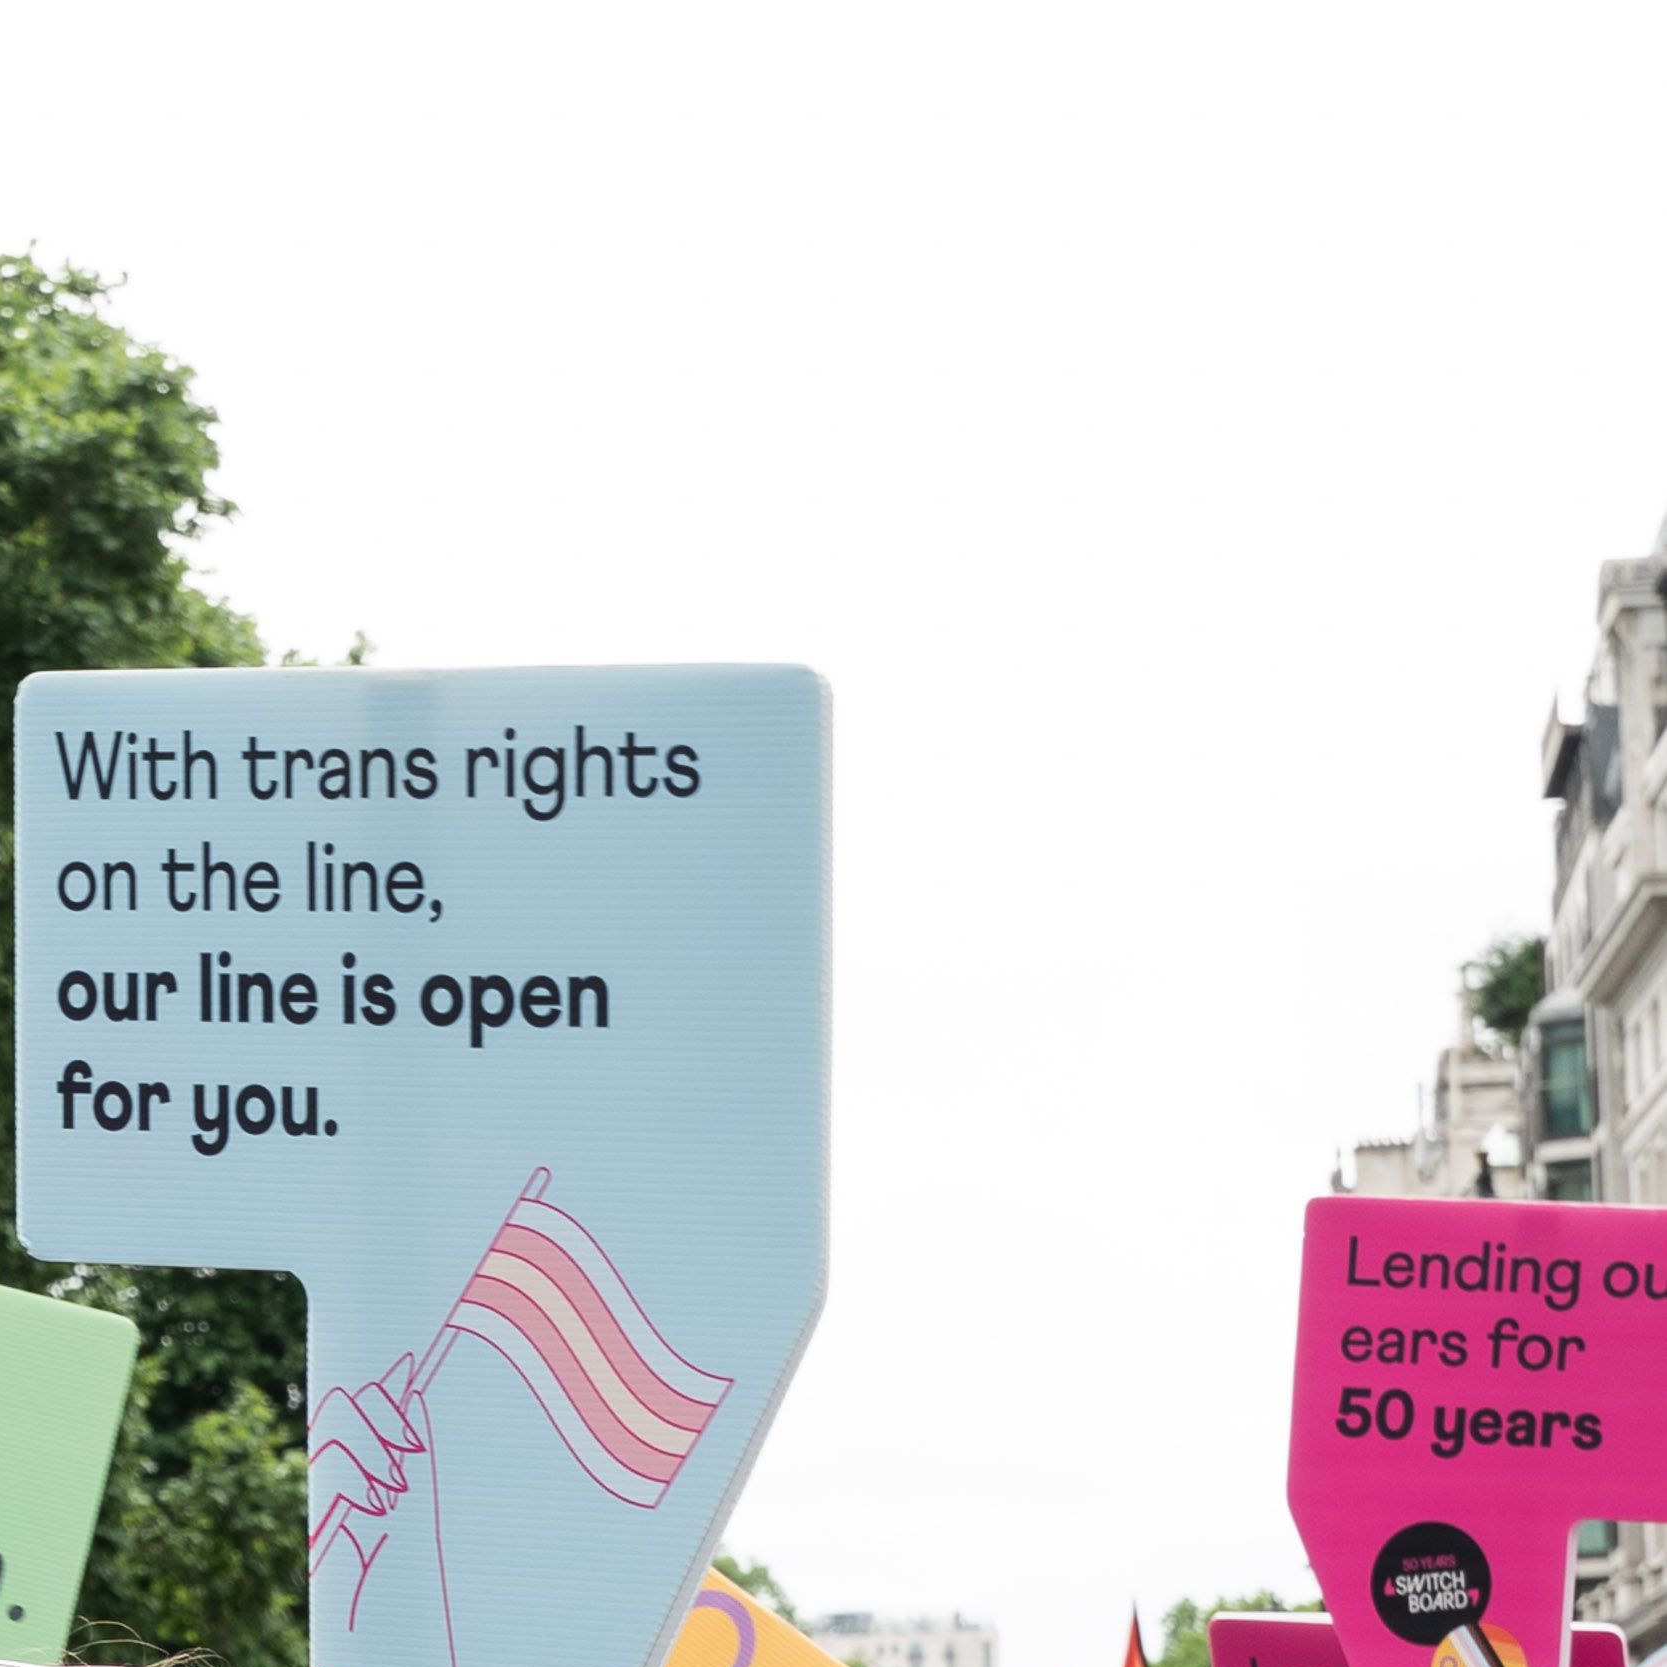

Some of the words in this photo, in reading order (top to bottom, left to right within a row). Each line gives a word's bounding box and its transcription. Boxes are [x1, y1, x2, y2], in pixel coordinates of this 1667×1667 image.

[56, 729, 217, 801] With
[243, 736, 439, 801] trans
[466, 725, 701, 822] rights
[57, 857, 137, 912] on
[161, 841, 281, 914] the
[307, 841, 444, 924] line,
[57, 970, 177, 1023] our
[198, 951, 318, 1024] line
[343, 952, 396, 1026] is
[420, 970, 610, 1049] open
[57, 1060, 170, 1132] for
[191, 1077, 338, 1156] you.
[1347, 1236, 1582, 1312] Lending
[1341, 1324, 1468, 1367] ears
[1488, 1318, 1586, 1371] for
[1336, 1388, 1414, 1439] 50
[1430, 1405, 1603, 1459] years
[1395, 1570, 1465, 1595] SWITCH
[1408, 1590, 1468, 1614] BOARD
